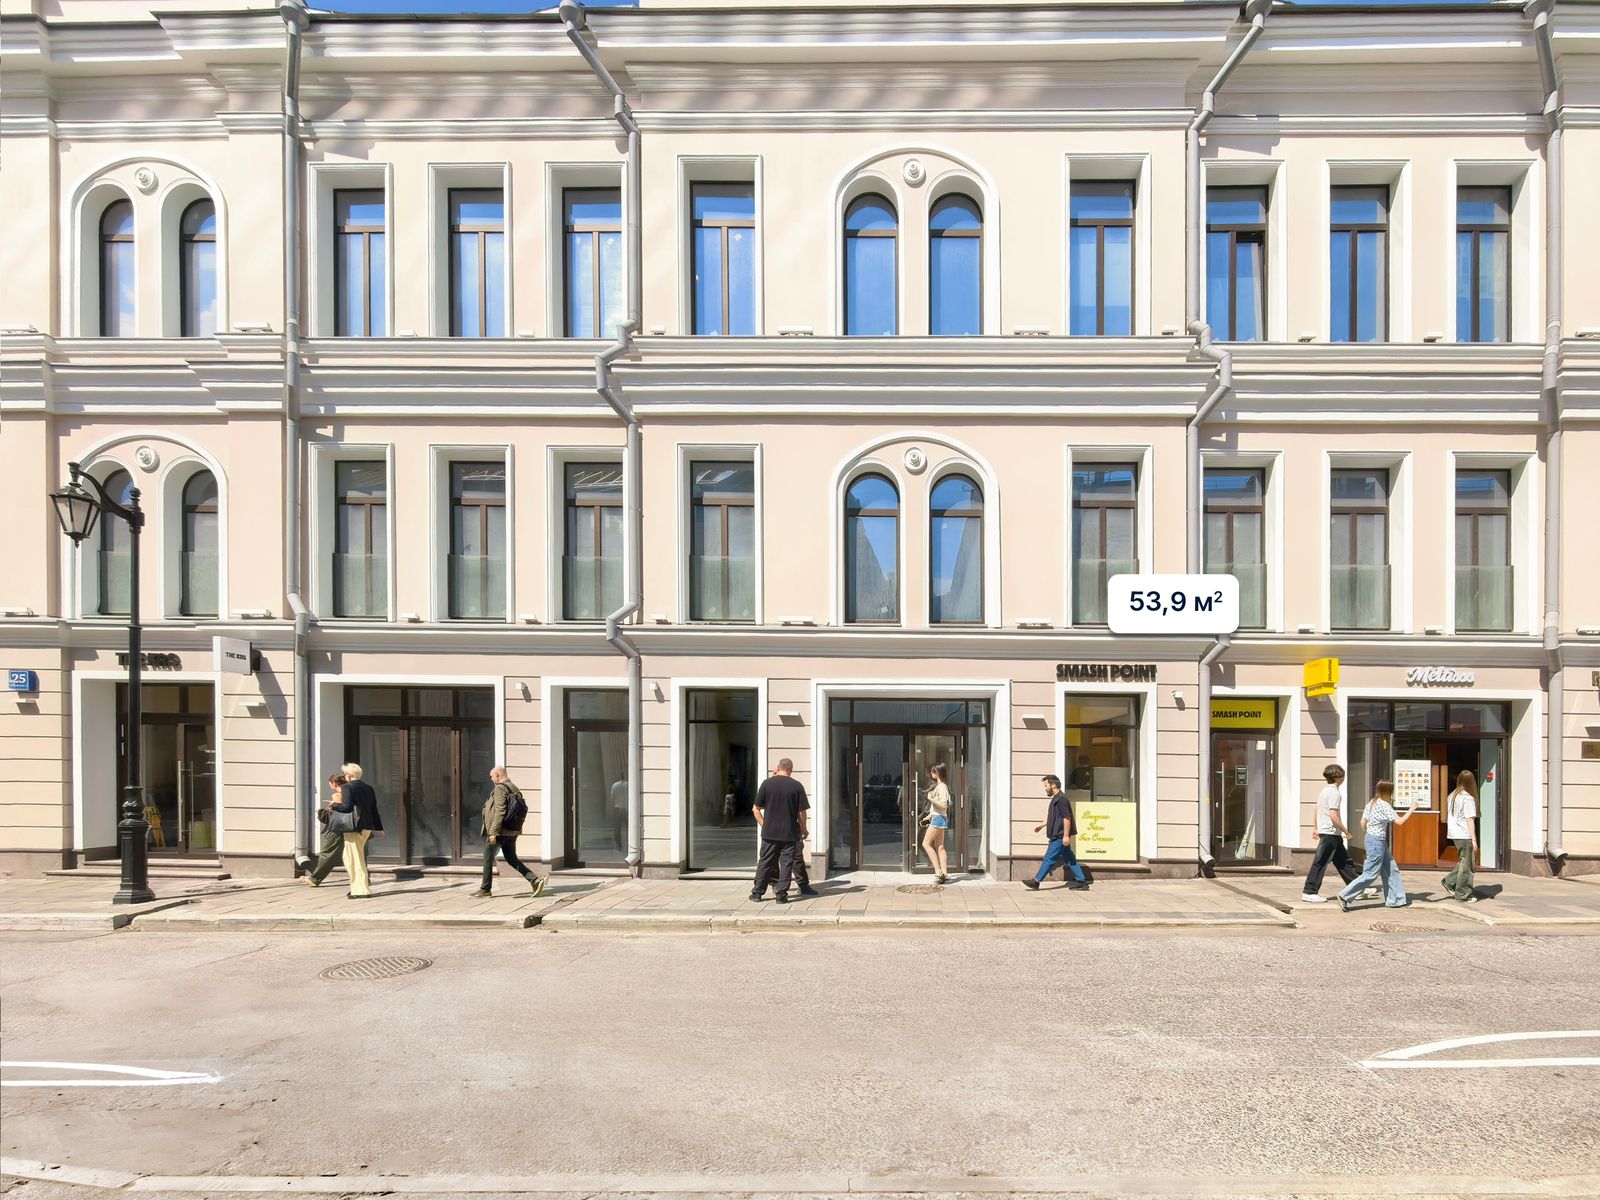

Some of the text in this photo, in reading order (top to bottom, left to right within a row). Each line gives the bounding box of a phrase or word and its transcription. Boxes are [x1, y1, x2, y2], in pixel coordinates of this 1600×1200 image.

[1056, 663, 1108, 680] SMASH
[11, 673, 26, 684] 25
[1211, 710, 1238, 719] SMASH
